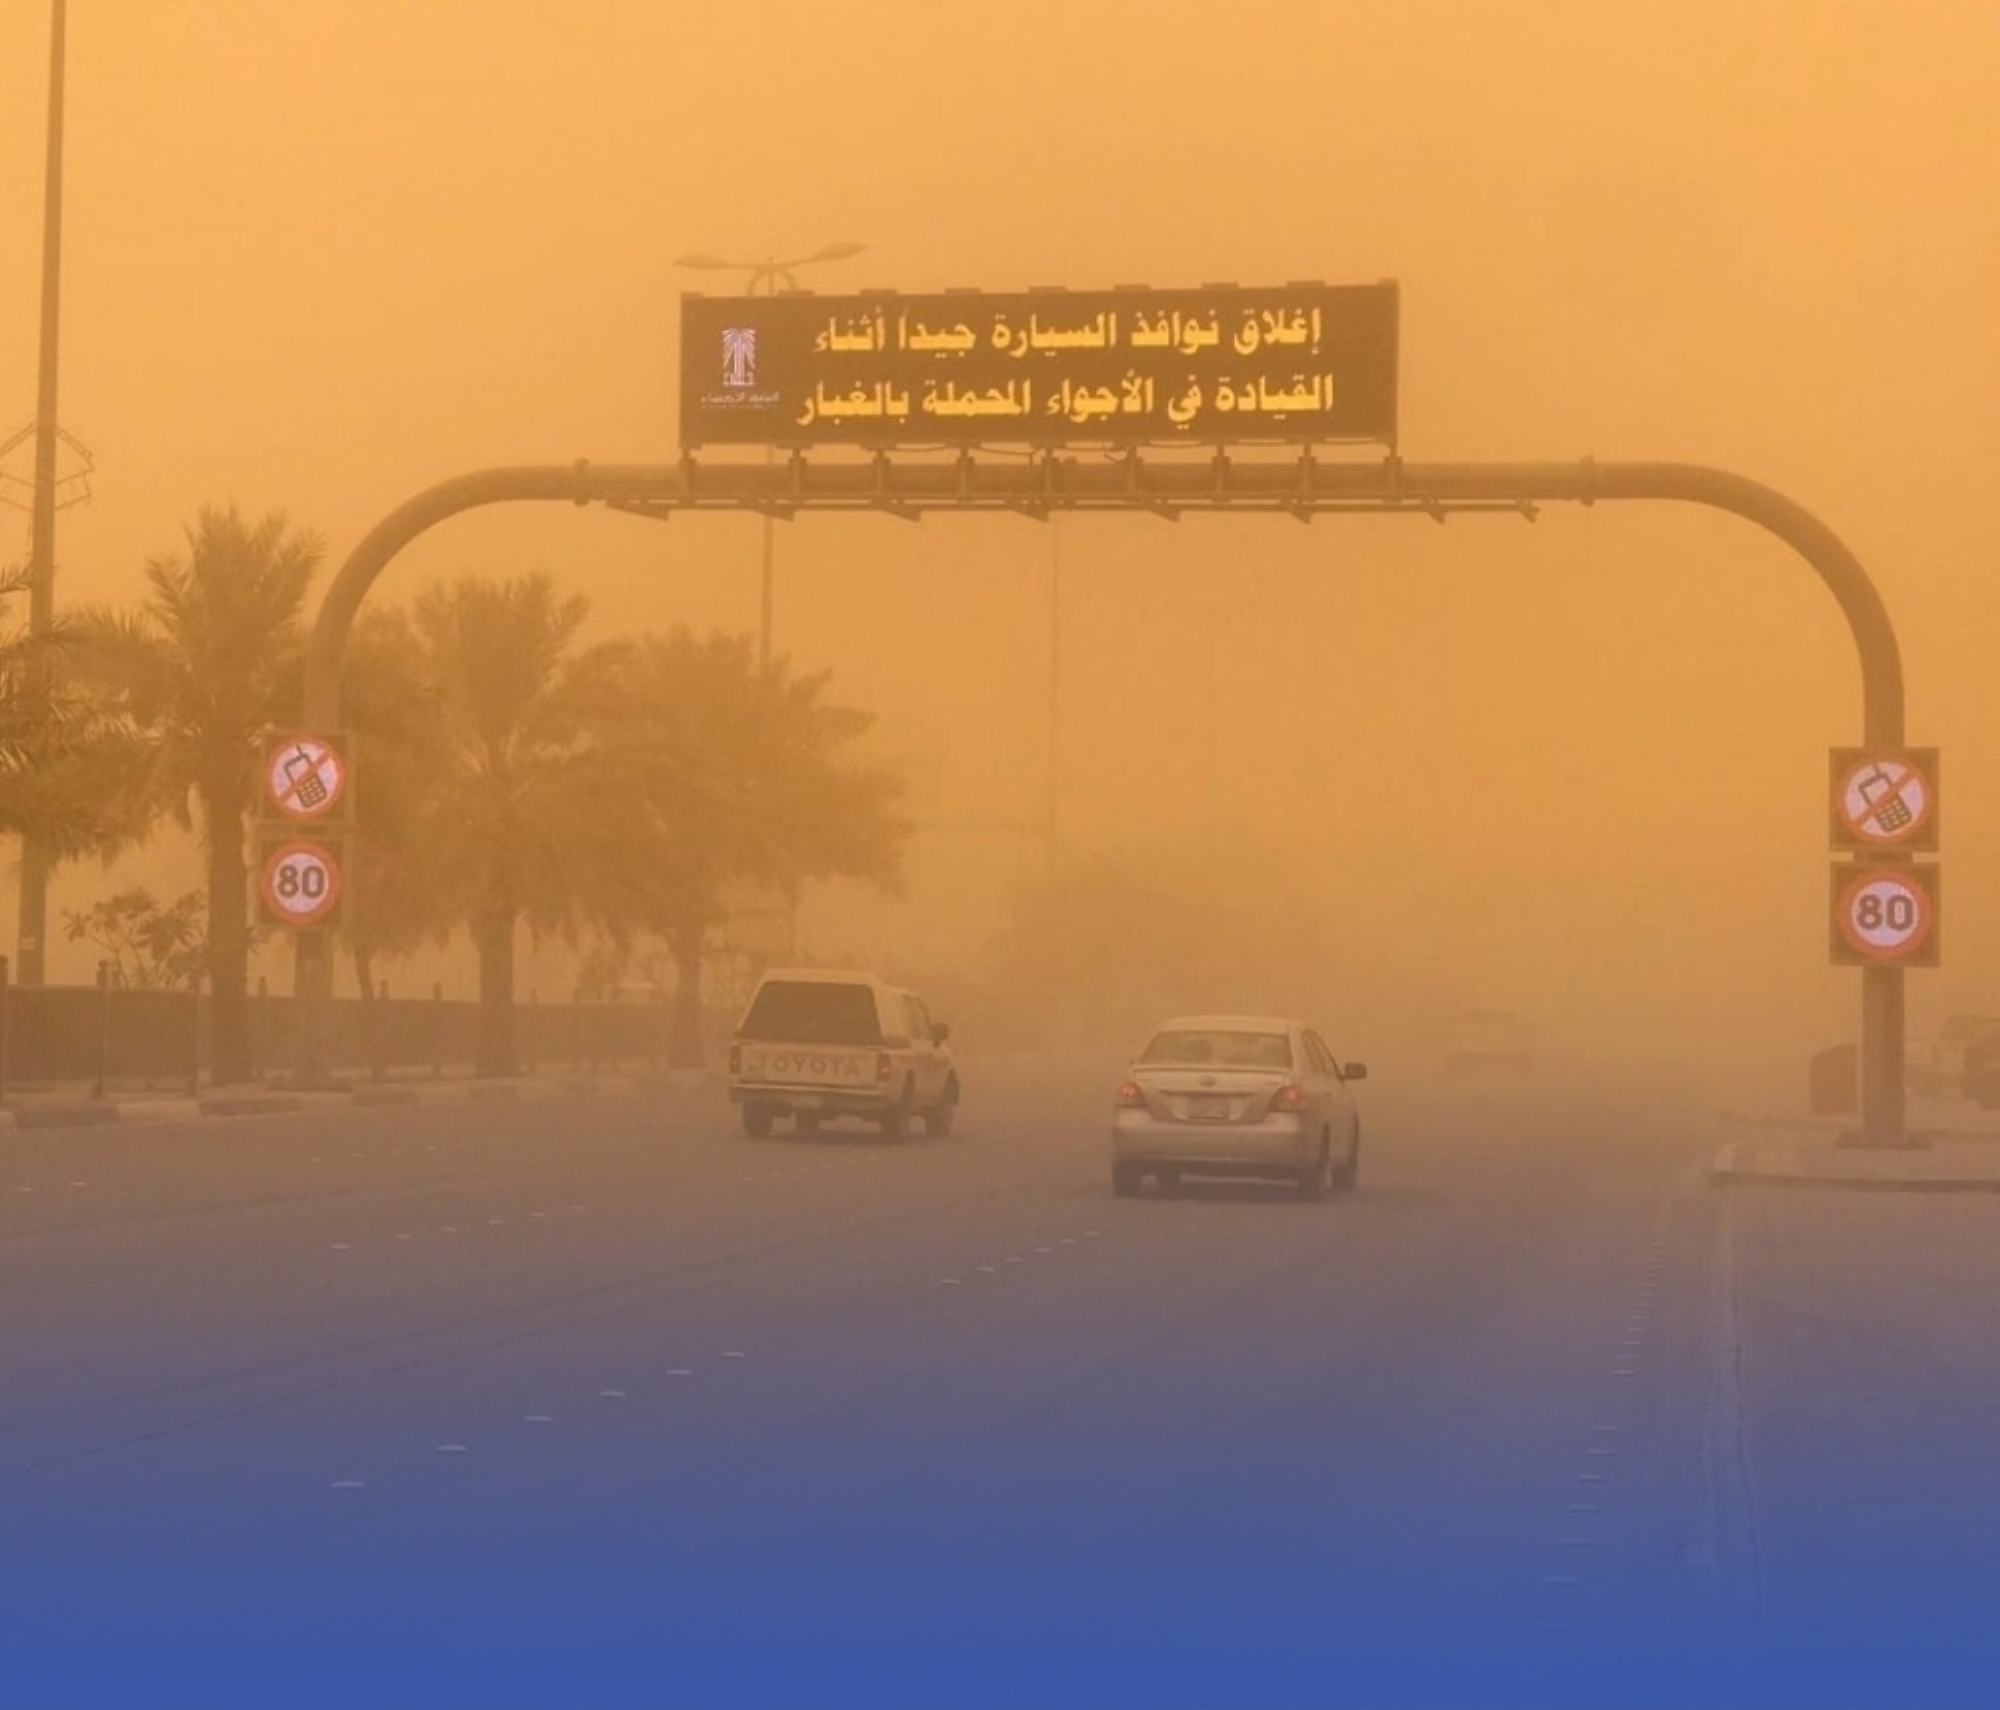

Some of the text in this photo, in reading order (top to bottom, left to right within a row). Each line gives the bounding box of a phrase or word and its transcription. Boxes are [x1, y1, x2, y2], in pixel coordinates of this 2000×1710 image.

[811, 306, 885, 351] أثناء
[991, 313, 1117, 357] السيارة
[1130, 309, 1219, 355] نوافذ
[1233, 307, 1321, 355] إغلاق
[797, 369, 1334, 430] القيادة في الأجواء المحملة بالغبار
[278, 865, 325, 898] 80
[1857, 894, 1914, 931] 80
